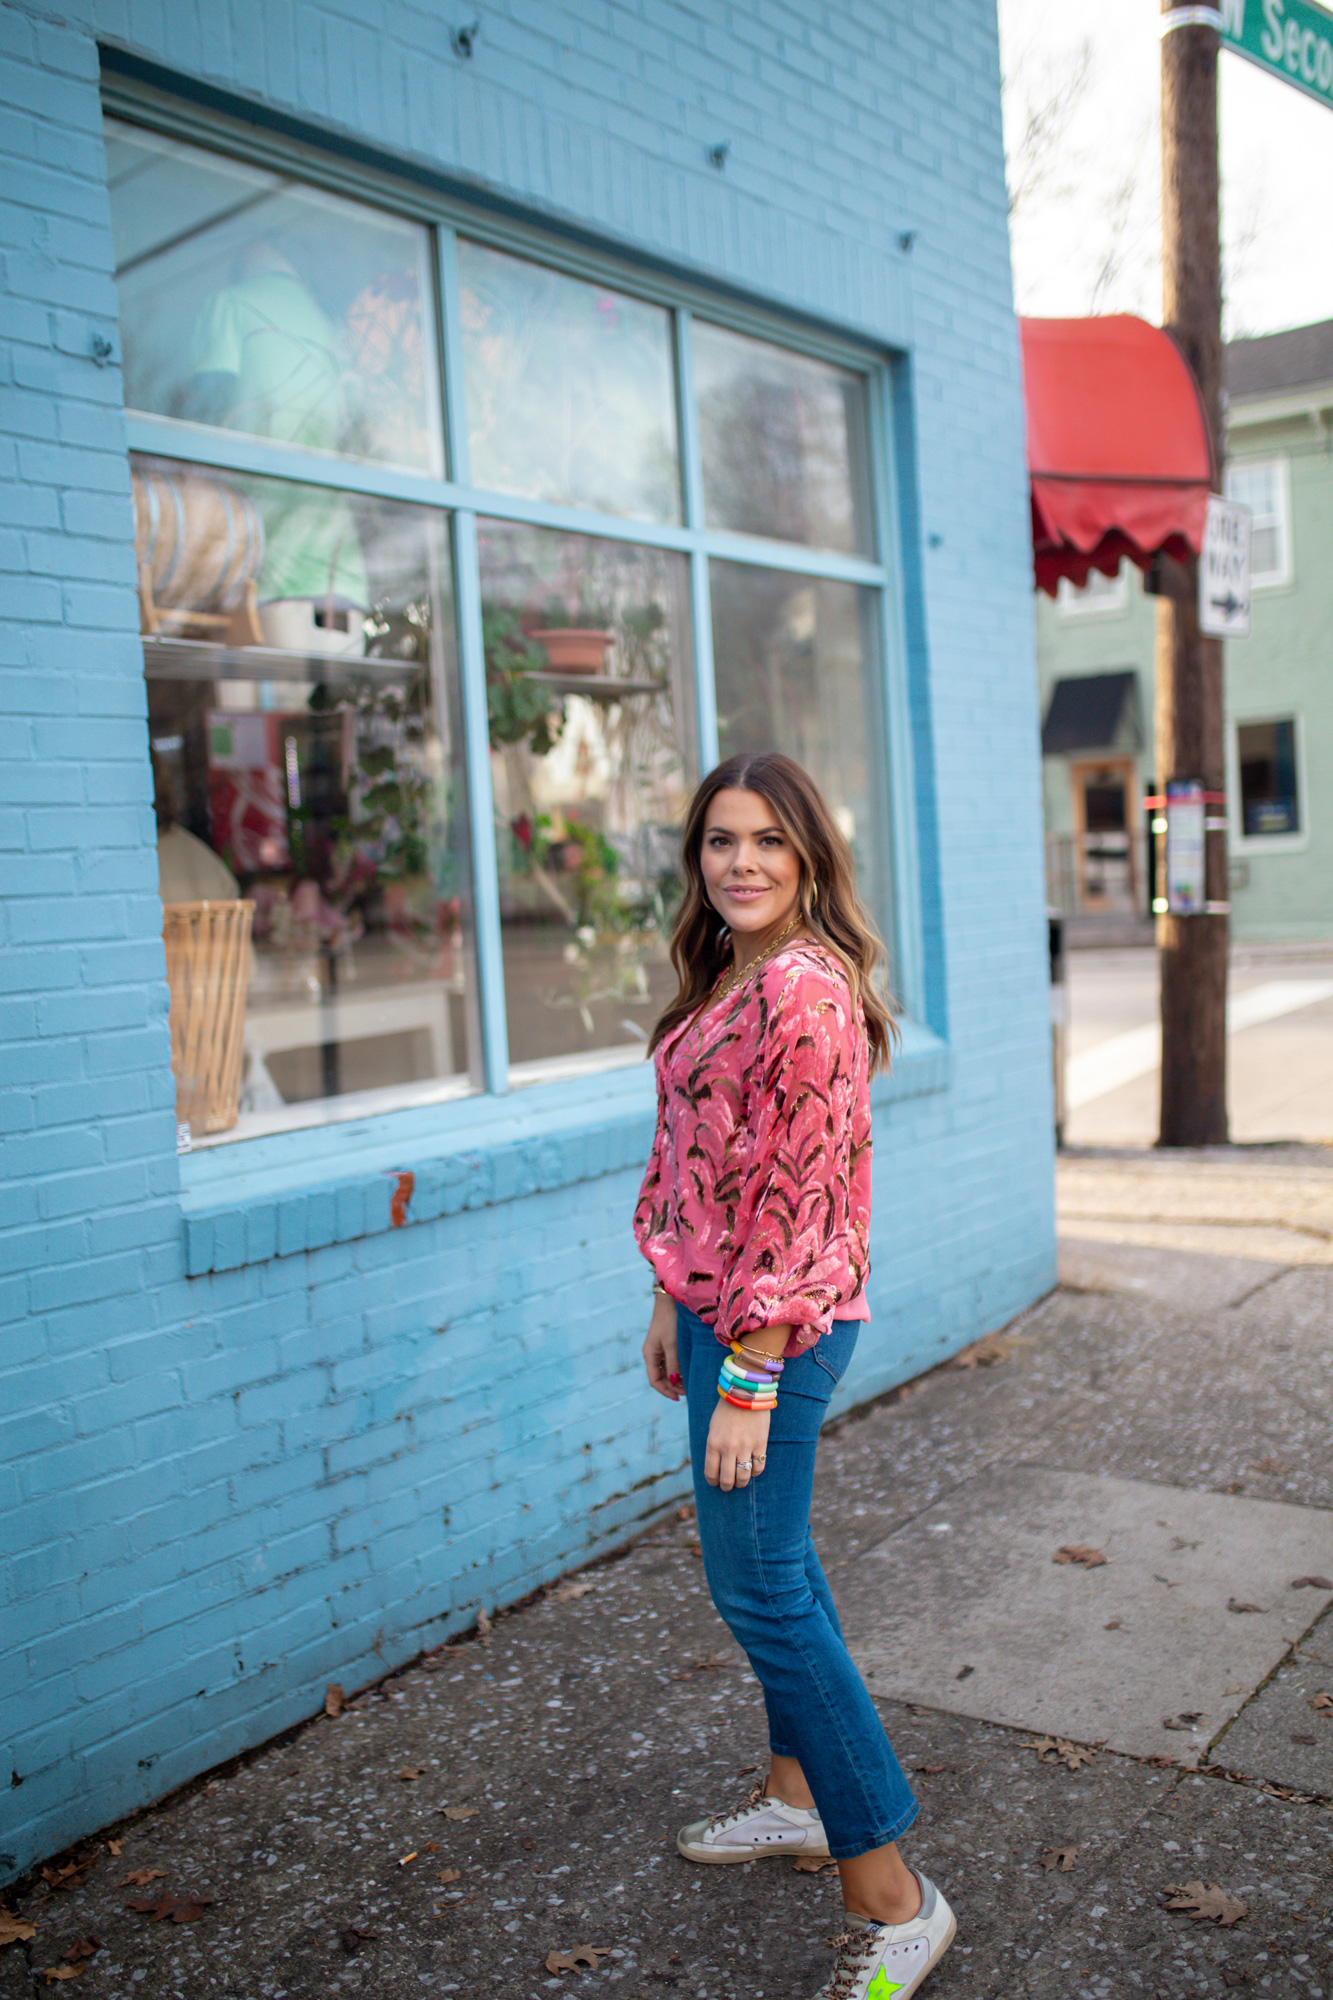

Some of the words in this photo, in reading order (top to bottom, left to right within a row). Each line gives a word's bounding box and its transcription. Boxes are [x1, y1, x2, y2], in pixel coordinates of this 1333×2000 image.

[1262, 0, 1333, 90] Seco
[1210, 514, 1245, 547] ONE
[1209, 551, 1246, 582] WAY
